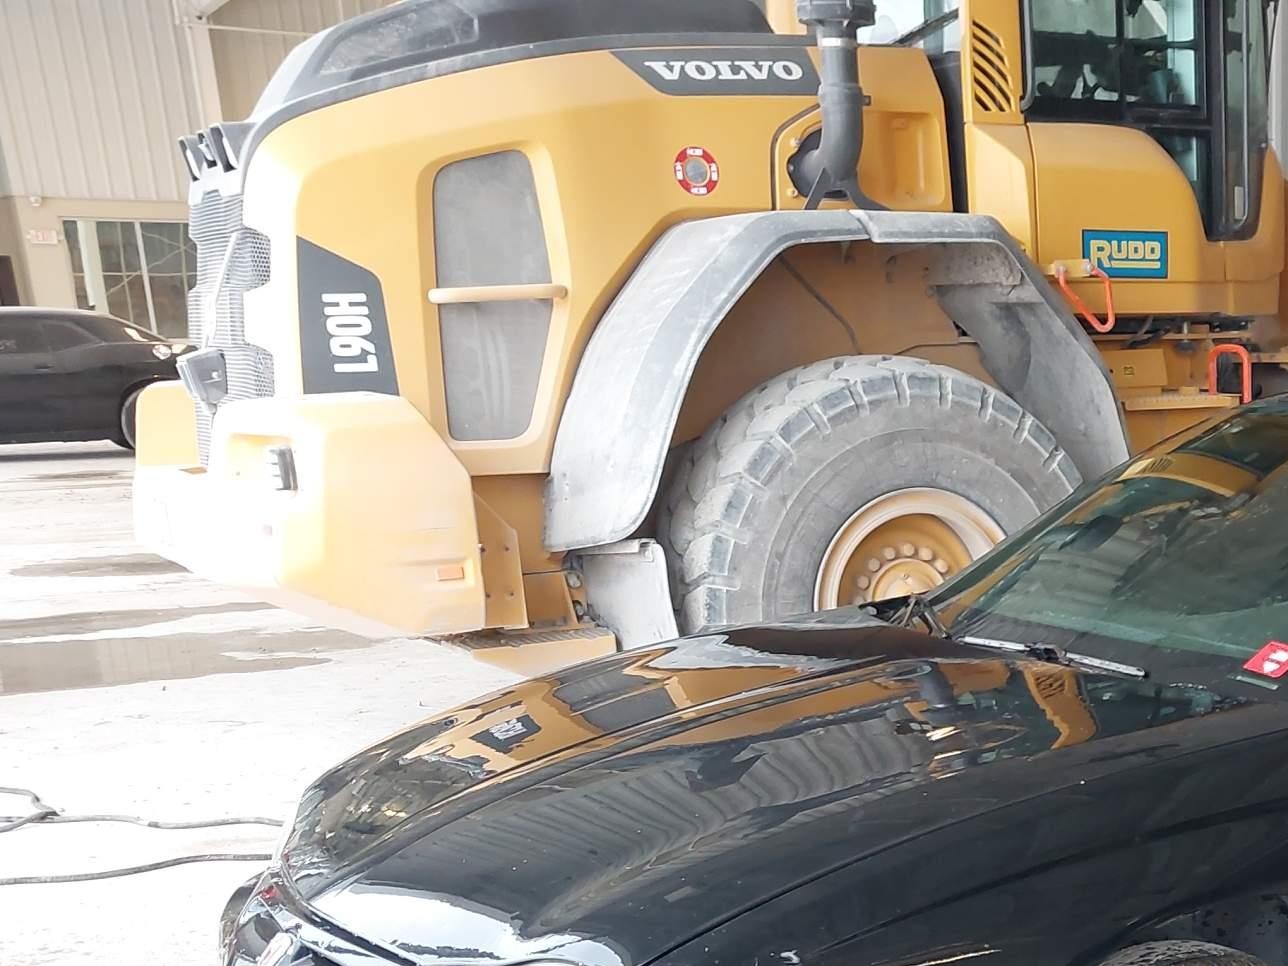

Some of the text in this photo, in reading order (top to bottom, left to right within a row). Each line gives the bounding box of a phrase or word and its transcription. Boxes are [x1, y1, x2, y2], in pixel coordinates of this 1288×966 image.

[644, 60, 803, 81] VOLVO
[1090, 239, 1161, 269] RUDD
[321, 292, 379, 374] L90H
